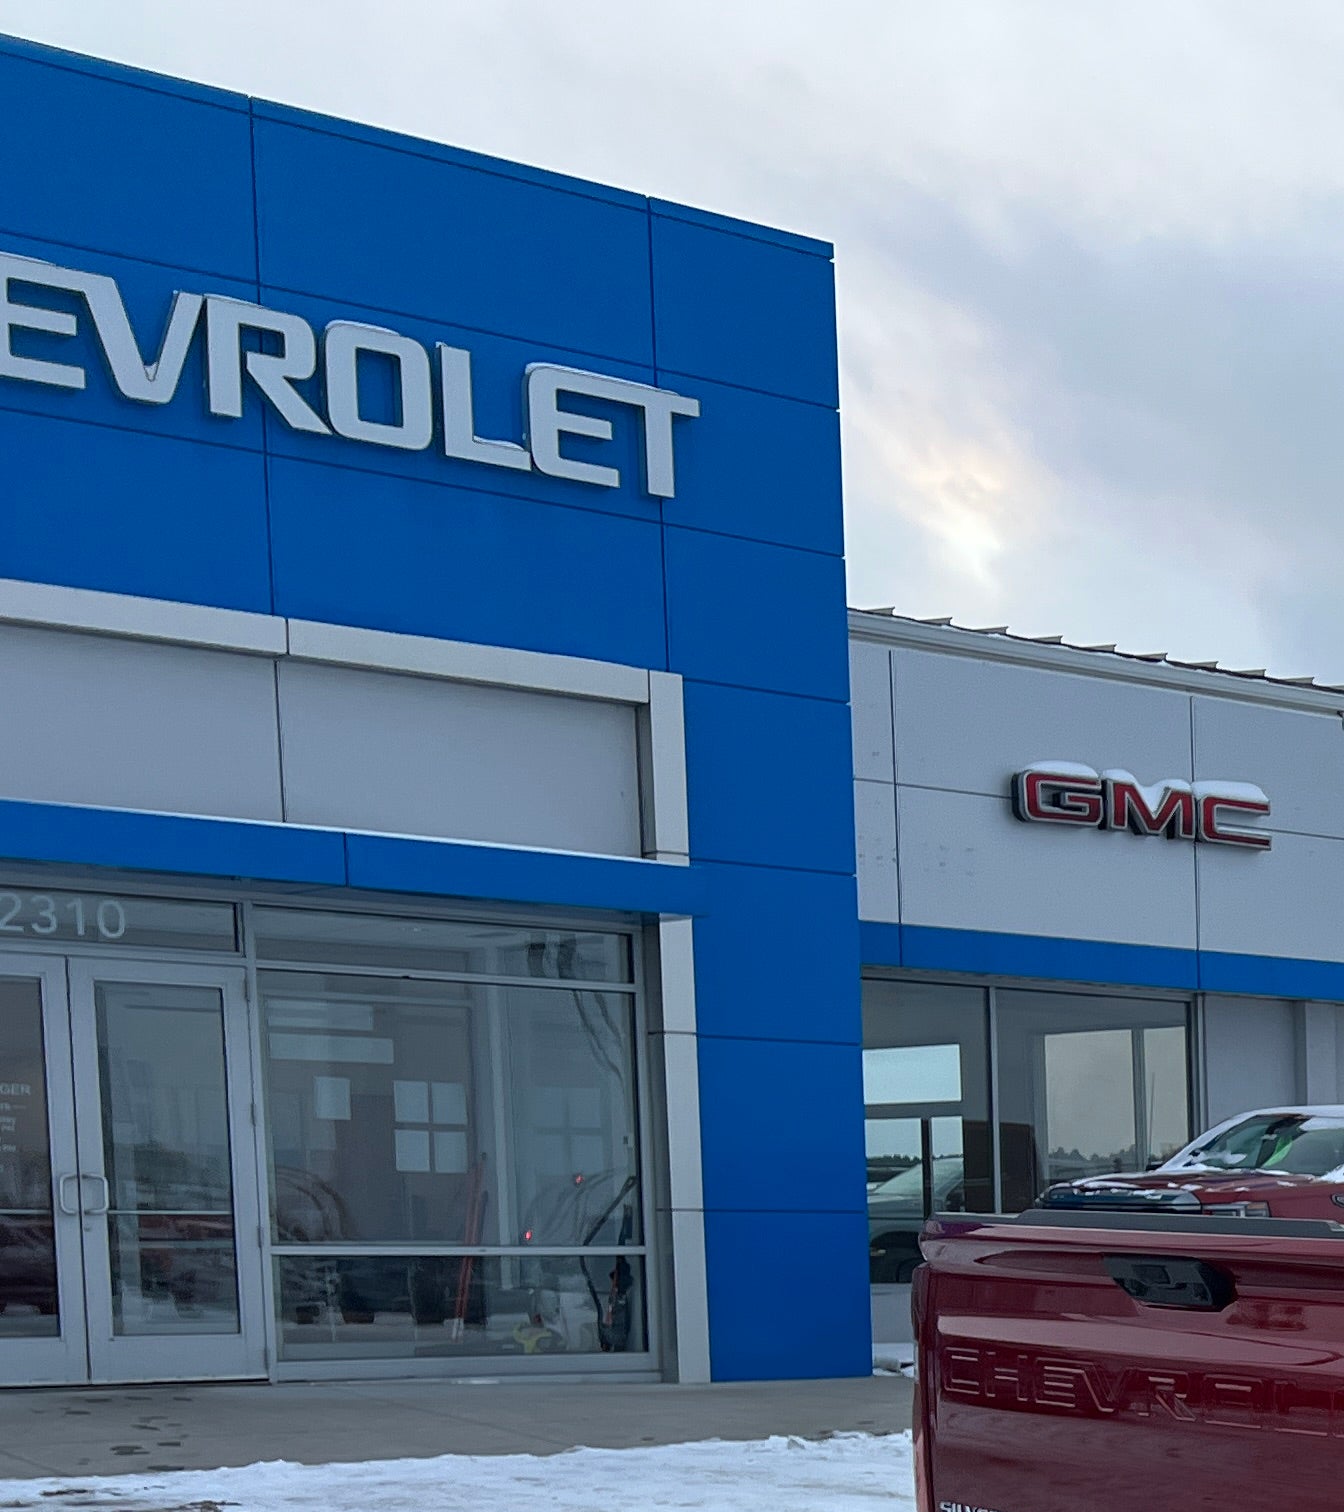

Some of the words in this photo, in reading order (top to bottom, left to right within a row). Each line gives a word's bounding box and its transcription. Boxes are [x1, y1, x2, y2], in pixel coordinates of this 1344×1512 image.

[0, 252, 700, 499] EVROLET
[1010, 764, 1272, 851] GMC
[0, 891, 126, 939] 2310
